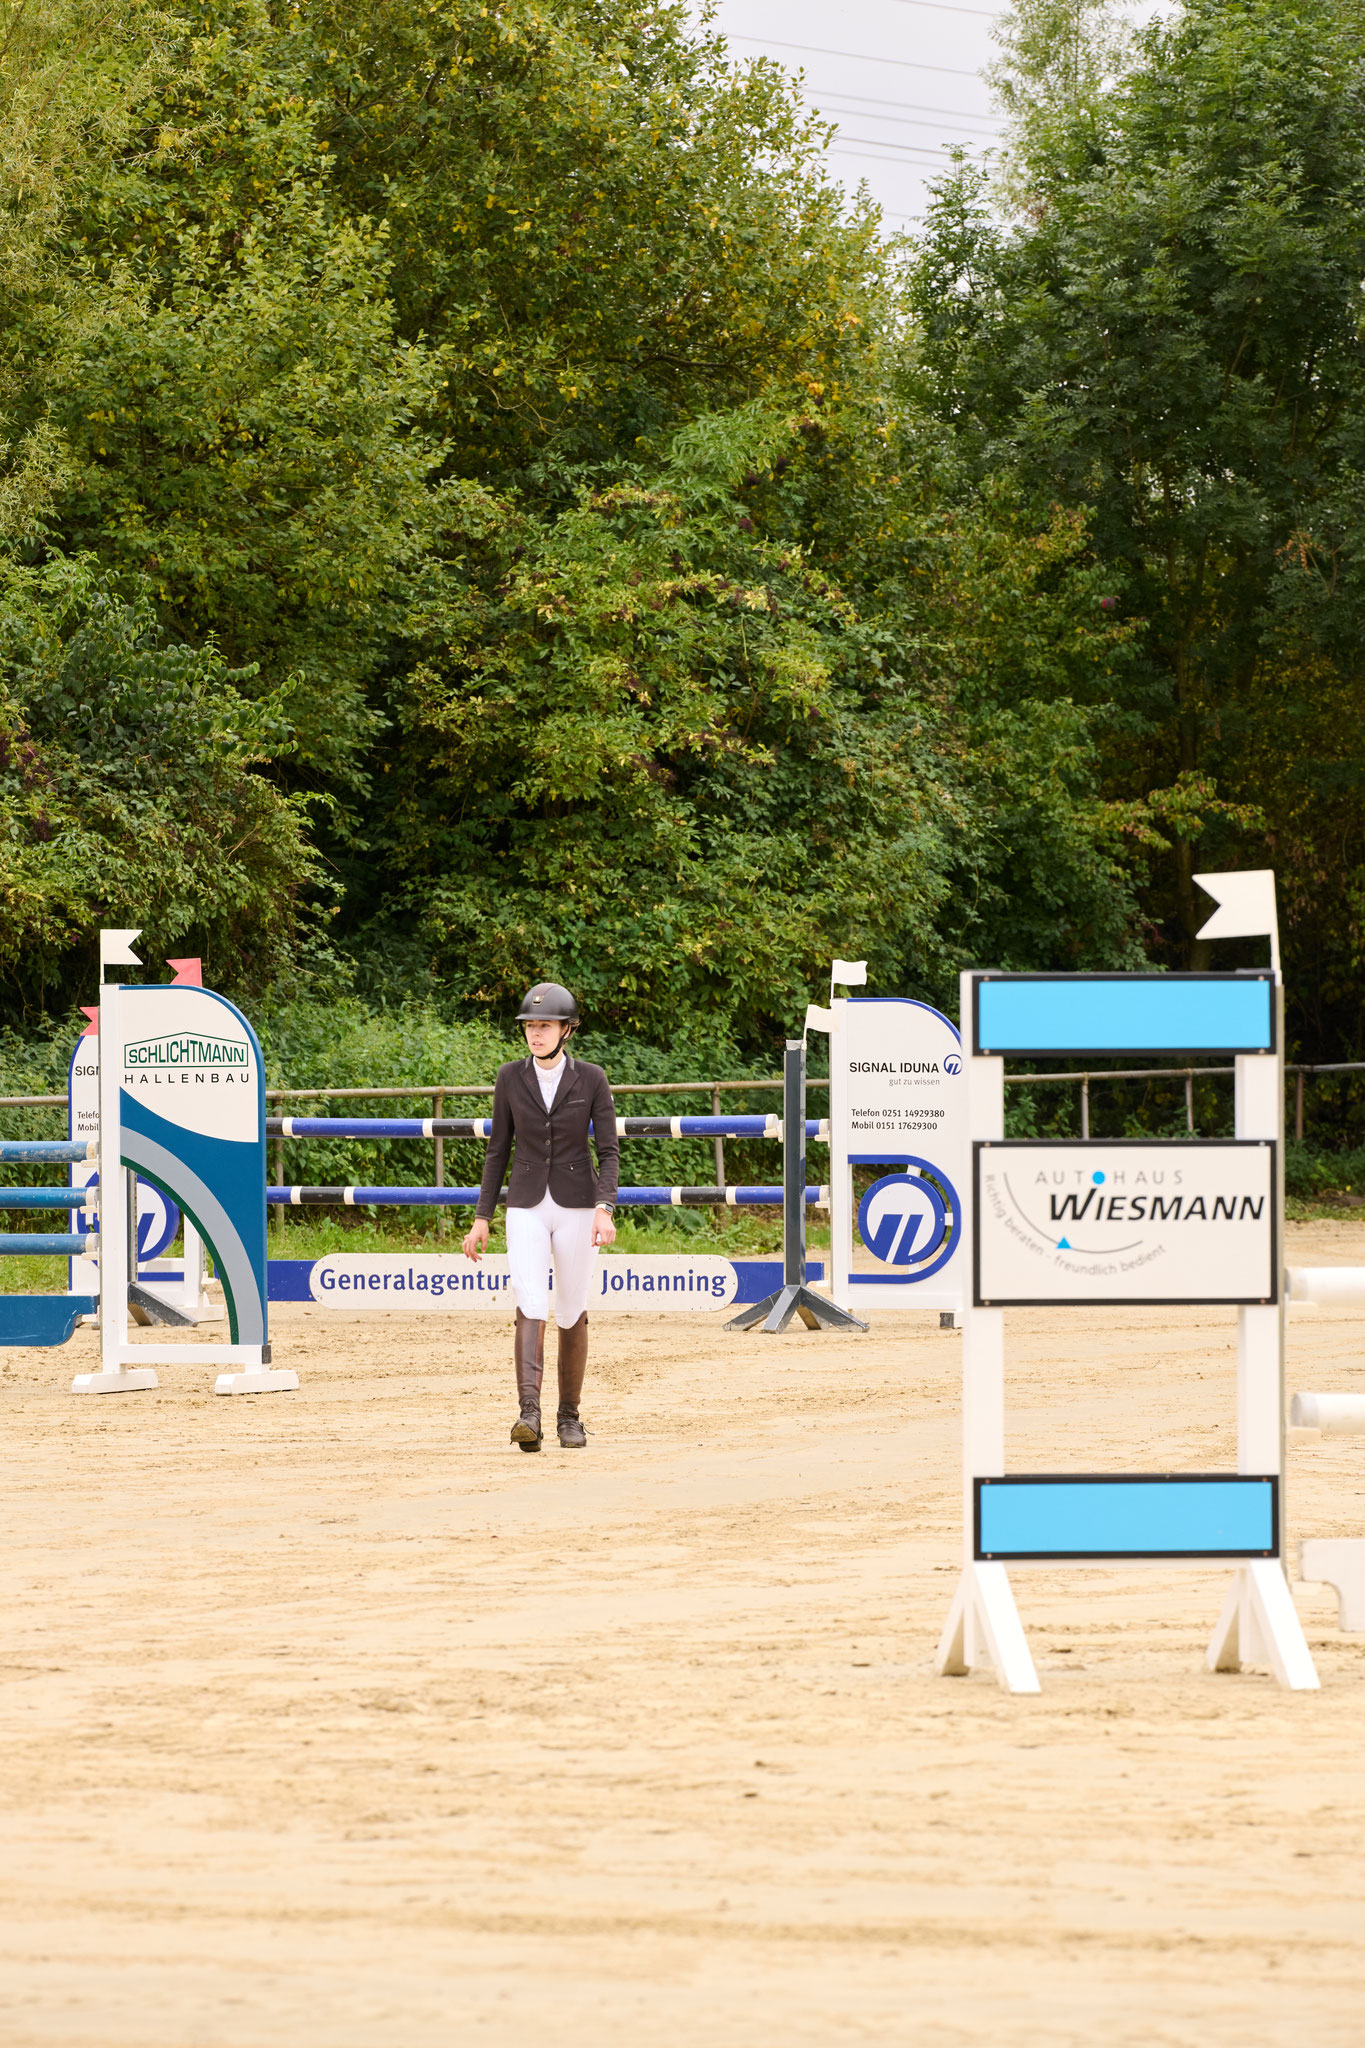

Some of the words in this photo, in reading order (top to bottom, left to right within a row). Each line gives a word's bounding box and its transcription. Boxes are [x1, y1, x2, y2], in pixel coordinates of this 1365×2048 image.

[128, 1039, 244, 1064] SCHLICHTMANN
[849, 1062, 897, 1073] SIGNAL
[900, 1062, 940, 1073] IDUNA
[124, 1073, 250, 1084] HALLENBAU
[889, 1079, 902, 1087] gut
[914, 1077, 940, 1086] wissen
[851, 1108, 880, 1117] Telefon
[882, 1109, 901, 1117] 0251
[905, 1109, 945, 1118] 14929380
[77, 1123, 99, 1131] Mobil
[851, 1121, 874, 1130] Mobil
[876, 1121, 895, 1130] 0151
[898, 1122, 938, 1131] 17629300
[1049, 1187, 1266, 1221] WIESMANN
[1004, 1216, 1045, 1256] beraten
[1054, 1255, 1118, 1276] freundlich
[1120, 1244, 1167, 1272] bedient
[319, 1267, 511, 1296] Generalagentur
[600, 1268, 727, 1298] Johanning
